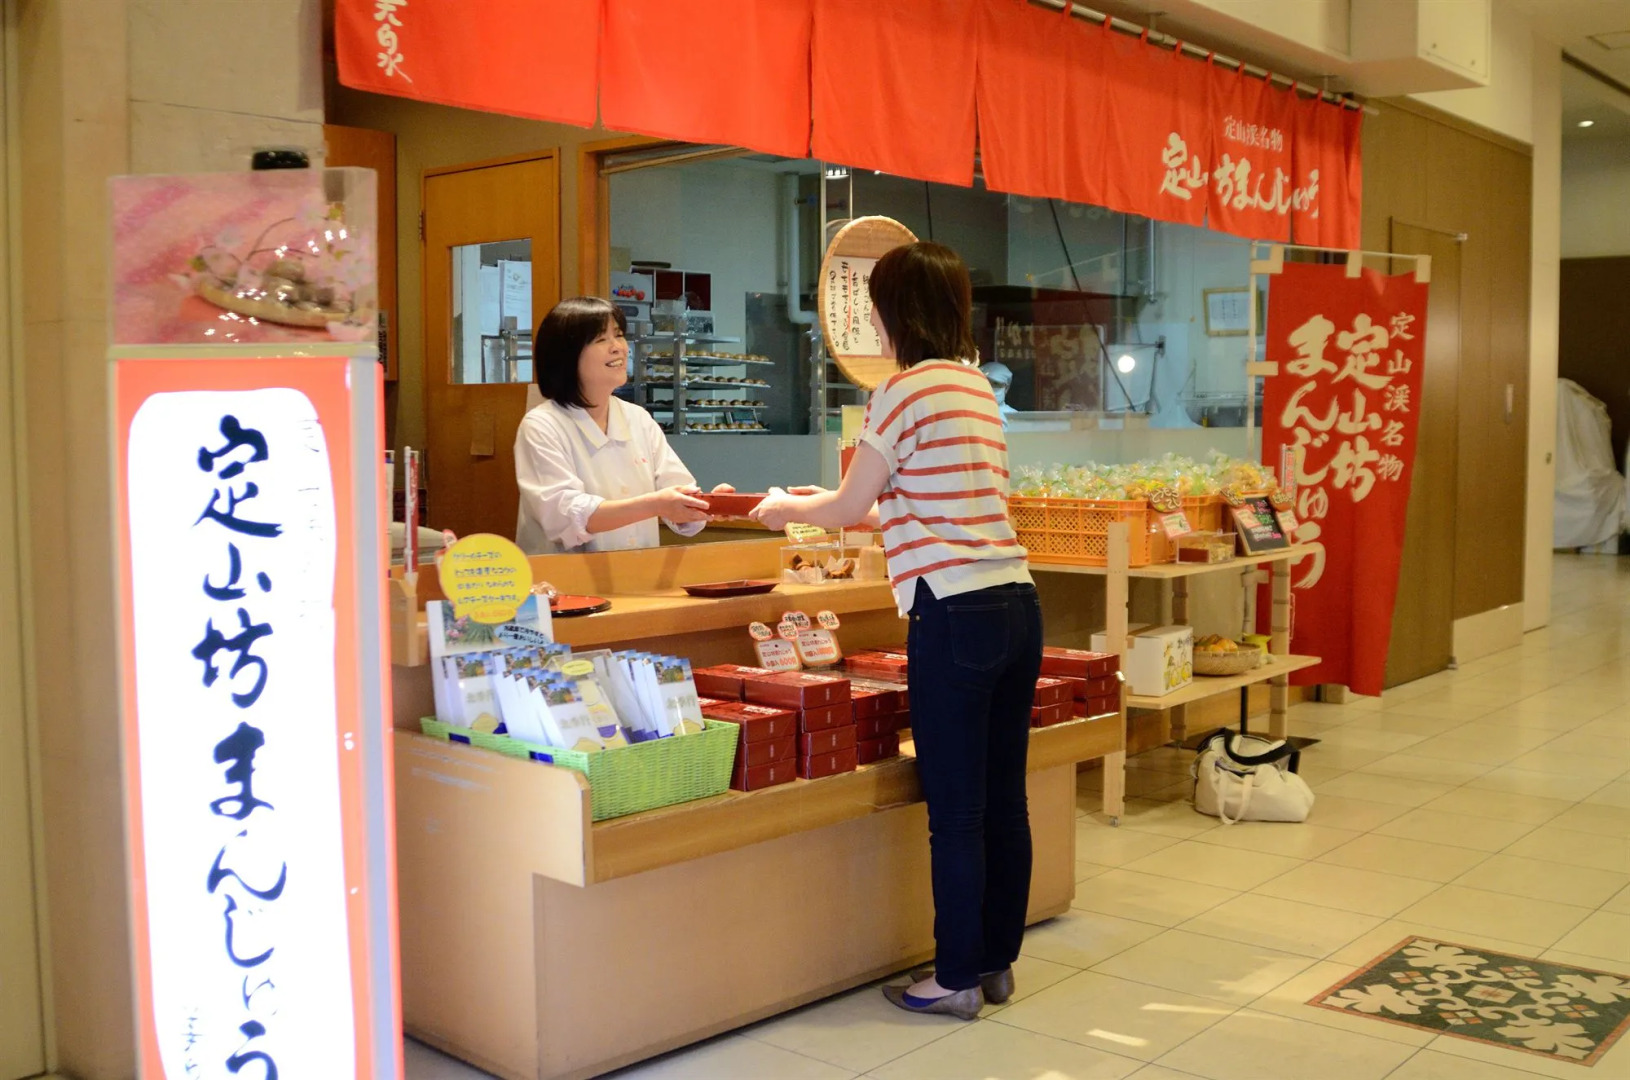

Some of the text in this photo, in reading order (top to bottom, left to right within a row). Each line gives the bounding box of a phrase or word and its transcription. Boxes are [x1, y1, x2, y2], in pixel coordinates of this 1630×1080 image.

[1281, 313, 1339, 590] まんじゅう
[1330, 312, 1394, 504] 定山坊
[1378, 311, 1416, 482] 定山渓名物
